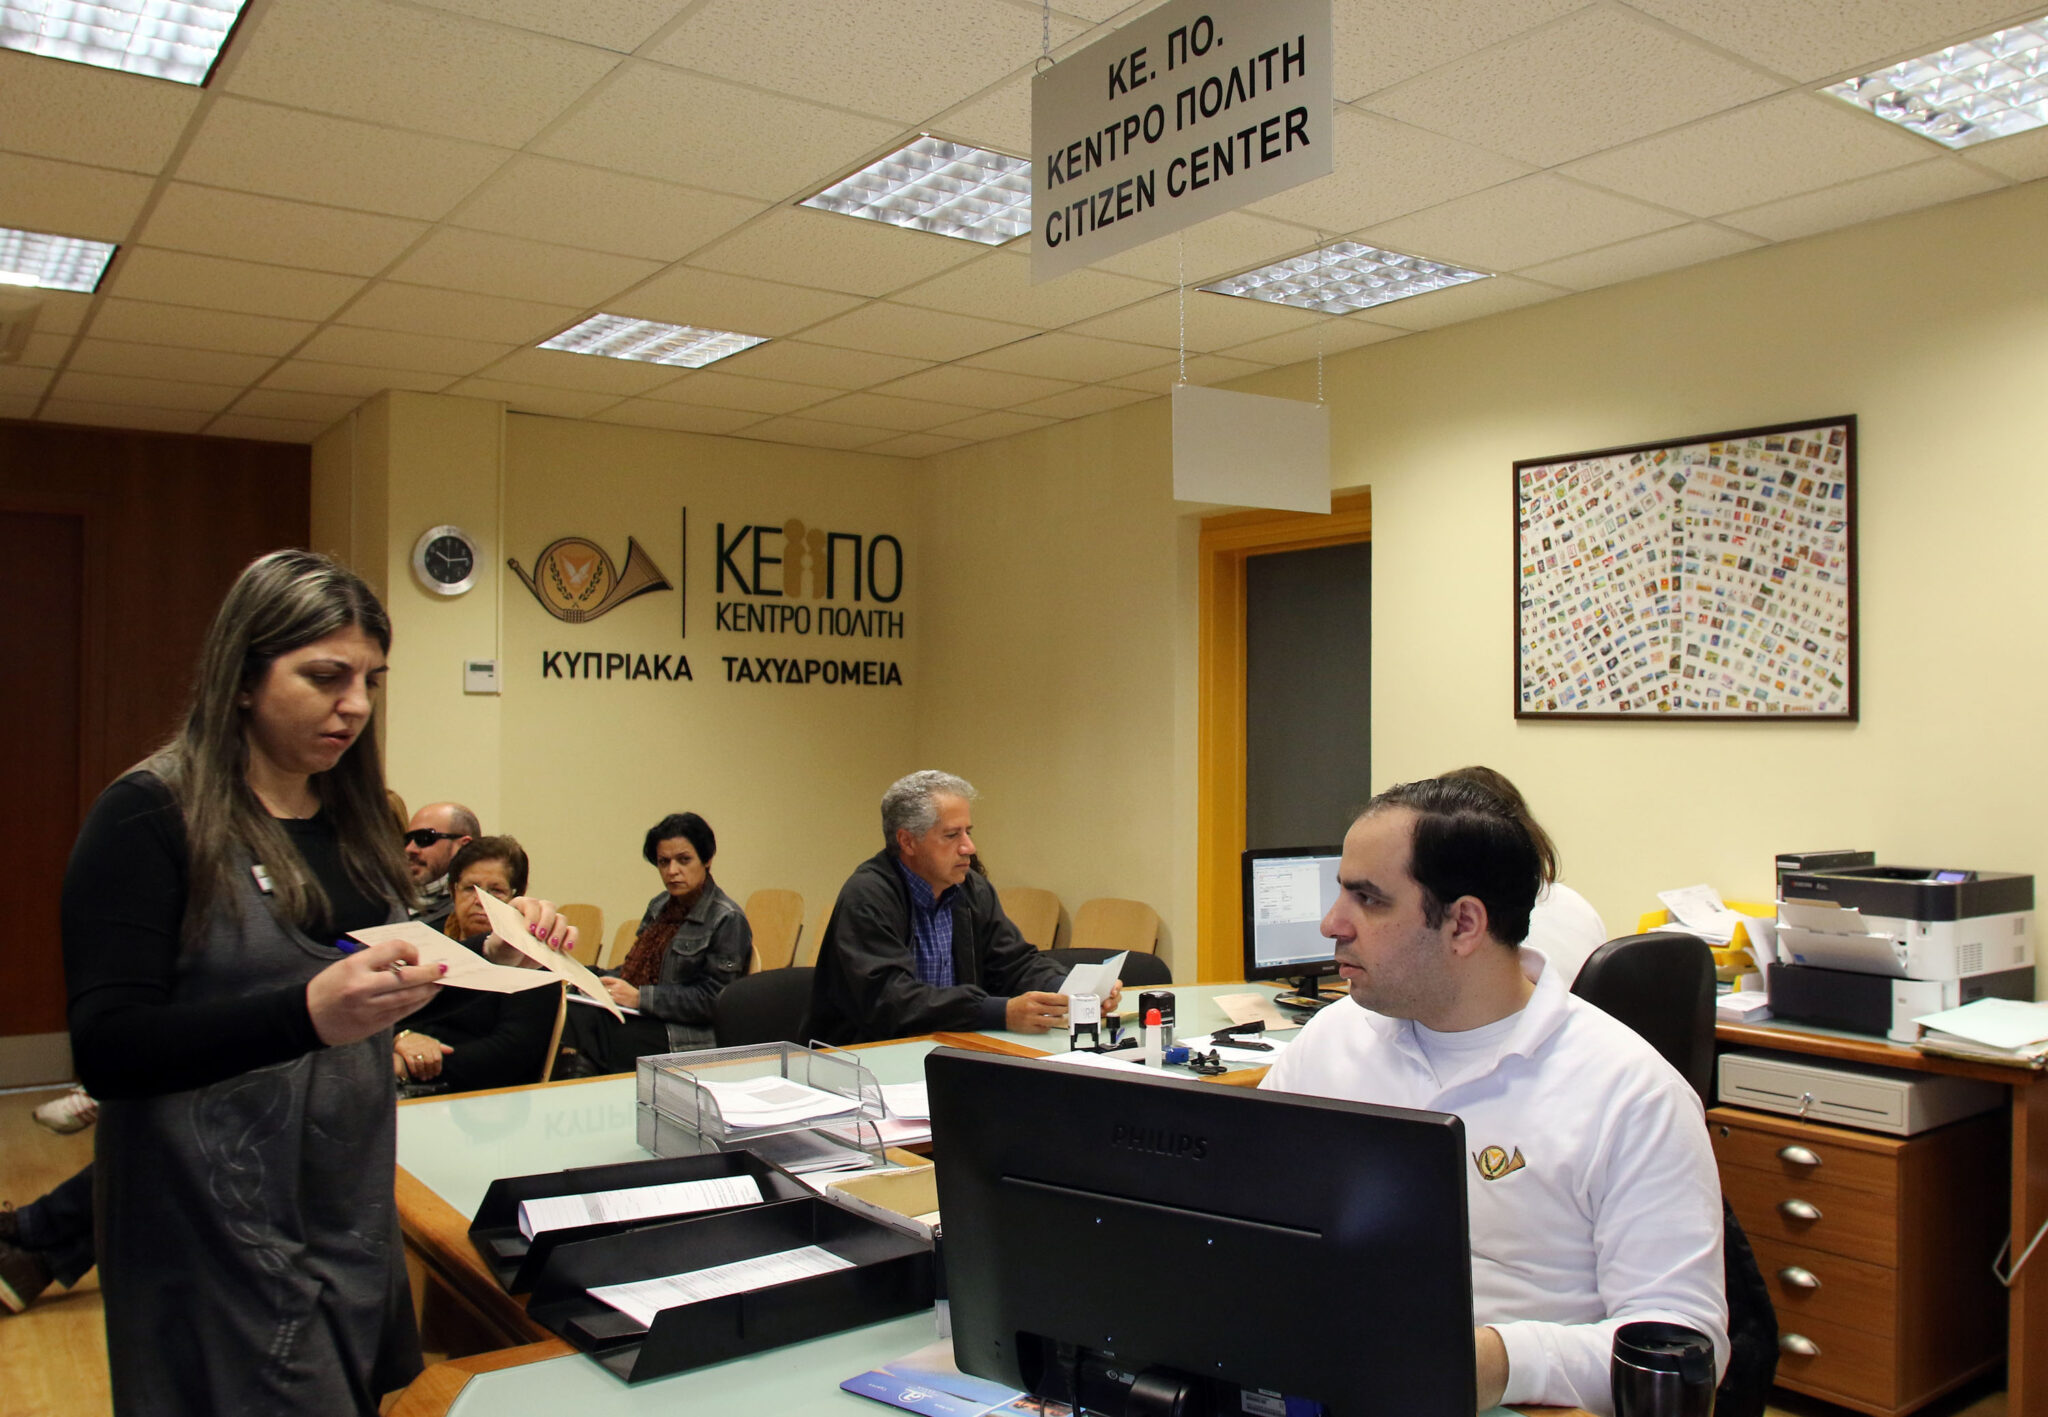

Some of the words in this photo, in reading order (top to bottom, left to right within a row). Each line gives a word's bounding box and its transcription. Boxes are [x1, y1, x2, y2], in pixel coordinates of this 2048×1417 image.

[1109, 47, 1156, 100] ΚΕ.
[1168, 15, 1223, 71] ΠΟ.
[1047, 104, 1165, 190] ΚΕΝΤΡΟ
[1176, 34, 1305, 132] ΠΟΛΙΤΗ
[1045, 169, 1155, 248] CITIZEN
[1167, 106, 1311, 198] CENTER
[716, 602, 811, 635] ΚΕΝΤΡΟ
[818, 607, 904, 639] ΠΟΛΙΤΗ
[543, 651, 693, 681] ΚΥΠΡΙΑΚΑ
[722, 656, 903, 686] ΤΑΧΥΔΡΟΜΕΙΑ
[1111, 1123, 1209, 1162] PHILIPS
